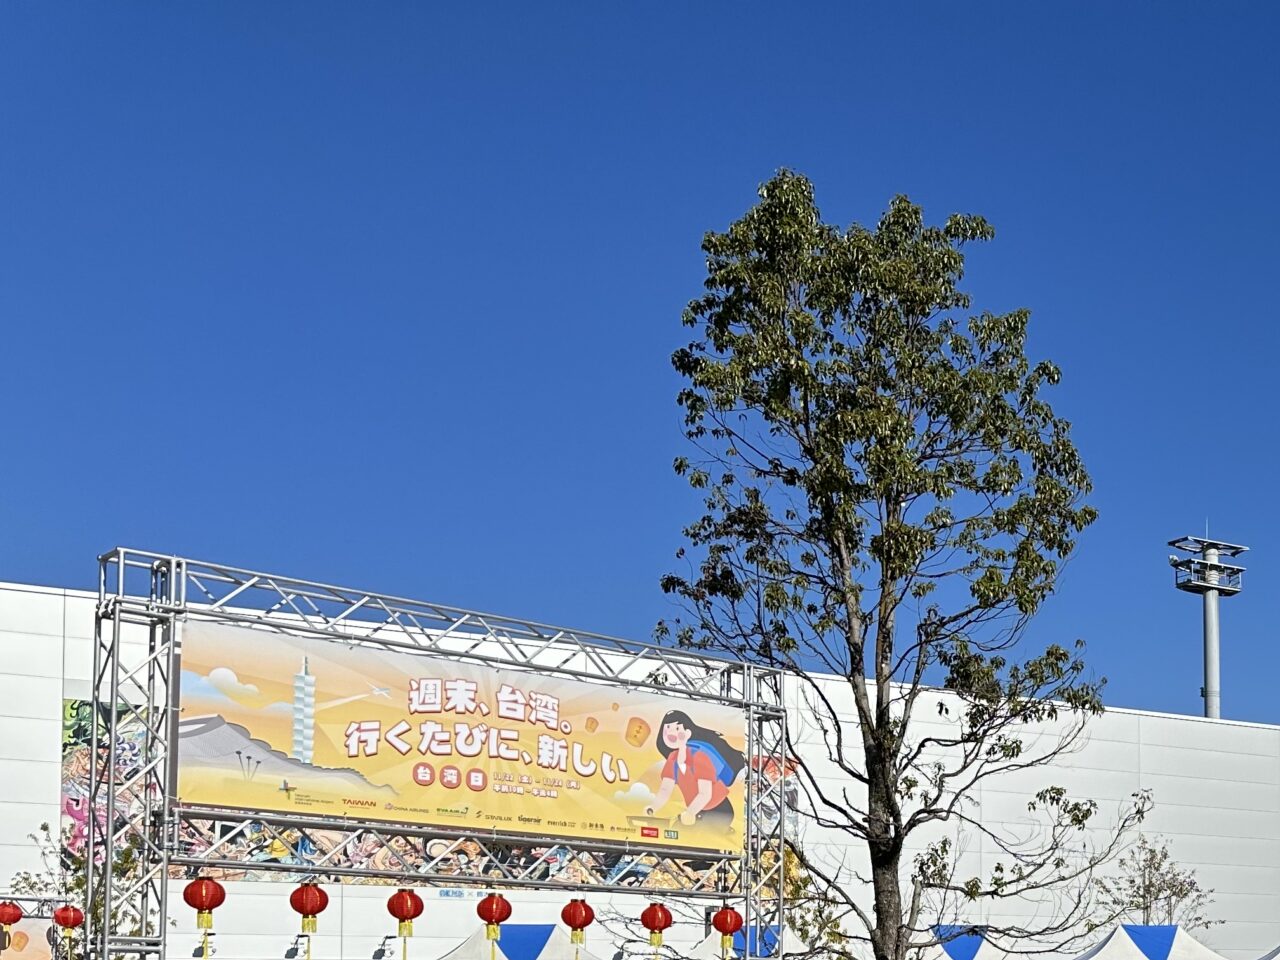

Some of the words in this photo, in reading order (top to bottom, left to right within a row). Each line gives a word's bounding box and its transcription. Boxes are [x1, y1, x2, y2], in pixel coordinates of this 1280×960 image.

[408, 678, 572, 734] 週末、台湾。
[345, 720, 629, 783] 行くたびに、新しい
[341, 798, 376, 808] TAIWAN
[485, 814, 513, 822] STARLUX
[517, 814, 542, 824] tigerair
